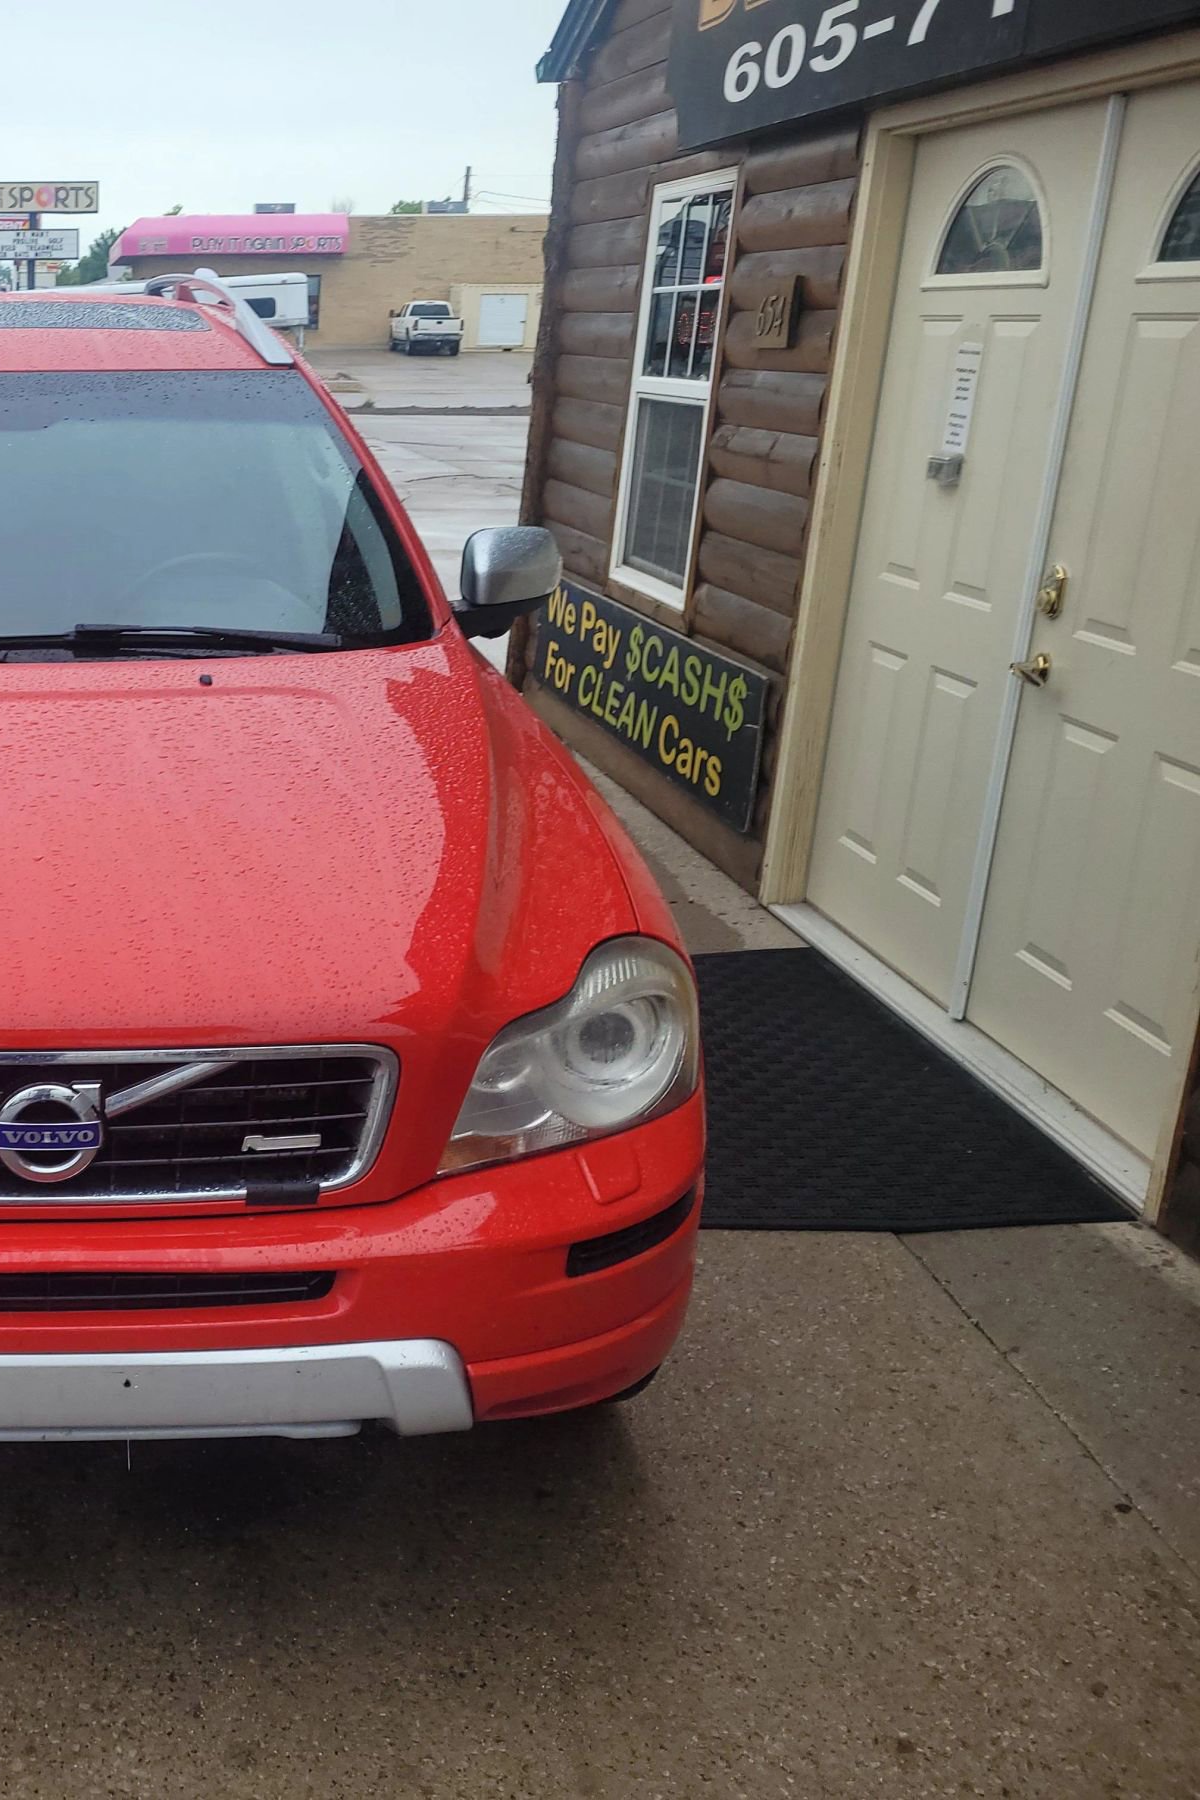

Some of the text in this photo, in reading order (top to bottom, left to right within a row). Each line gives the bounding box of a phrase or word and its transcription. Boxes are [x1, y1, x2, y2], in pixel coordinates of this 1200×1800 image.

[723, 0, 1014, 103] 605-7
[8, 186, 94, 208] SPORTS
[192, 236, 342, 251] PLAY IT AGAIN SPORTS
[756, 295, 786, 337] 654
[547, 586, 747, 742] We Pay $CASH$
[545, 640, 722, 797] For CLEAN Cars
[1, 1130, 94, 1143] VOLVO
